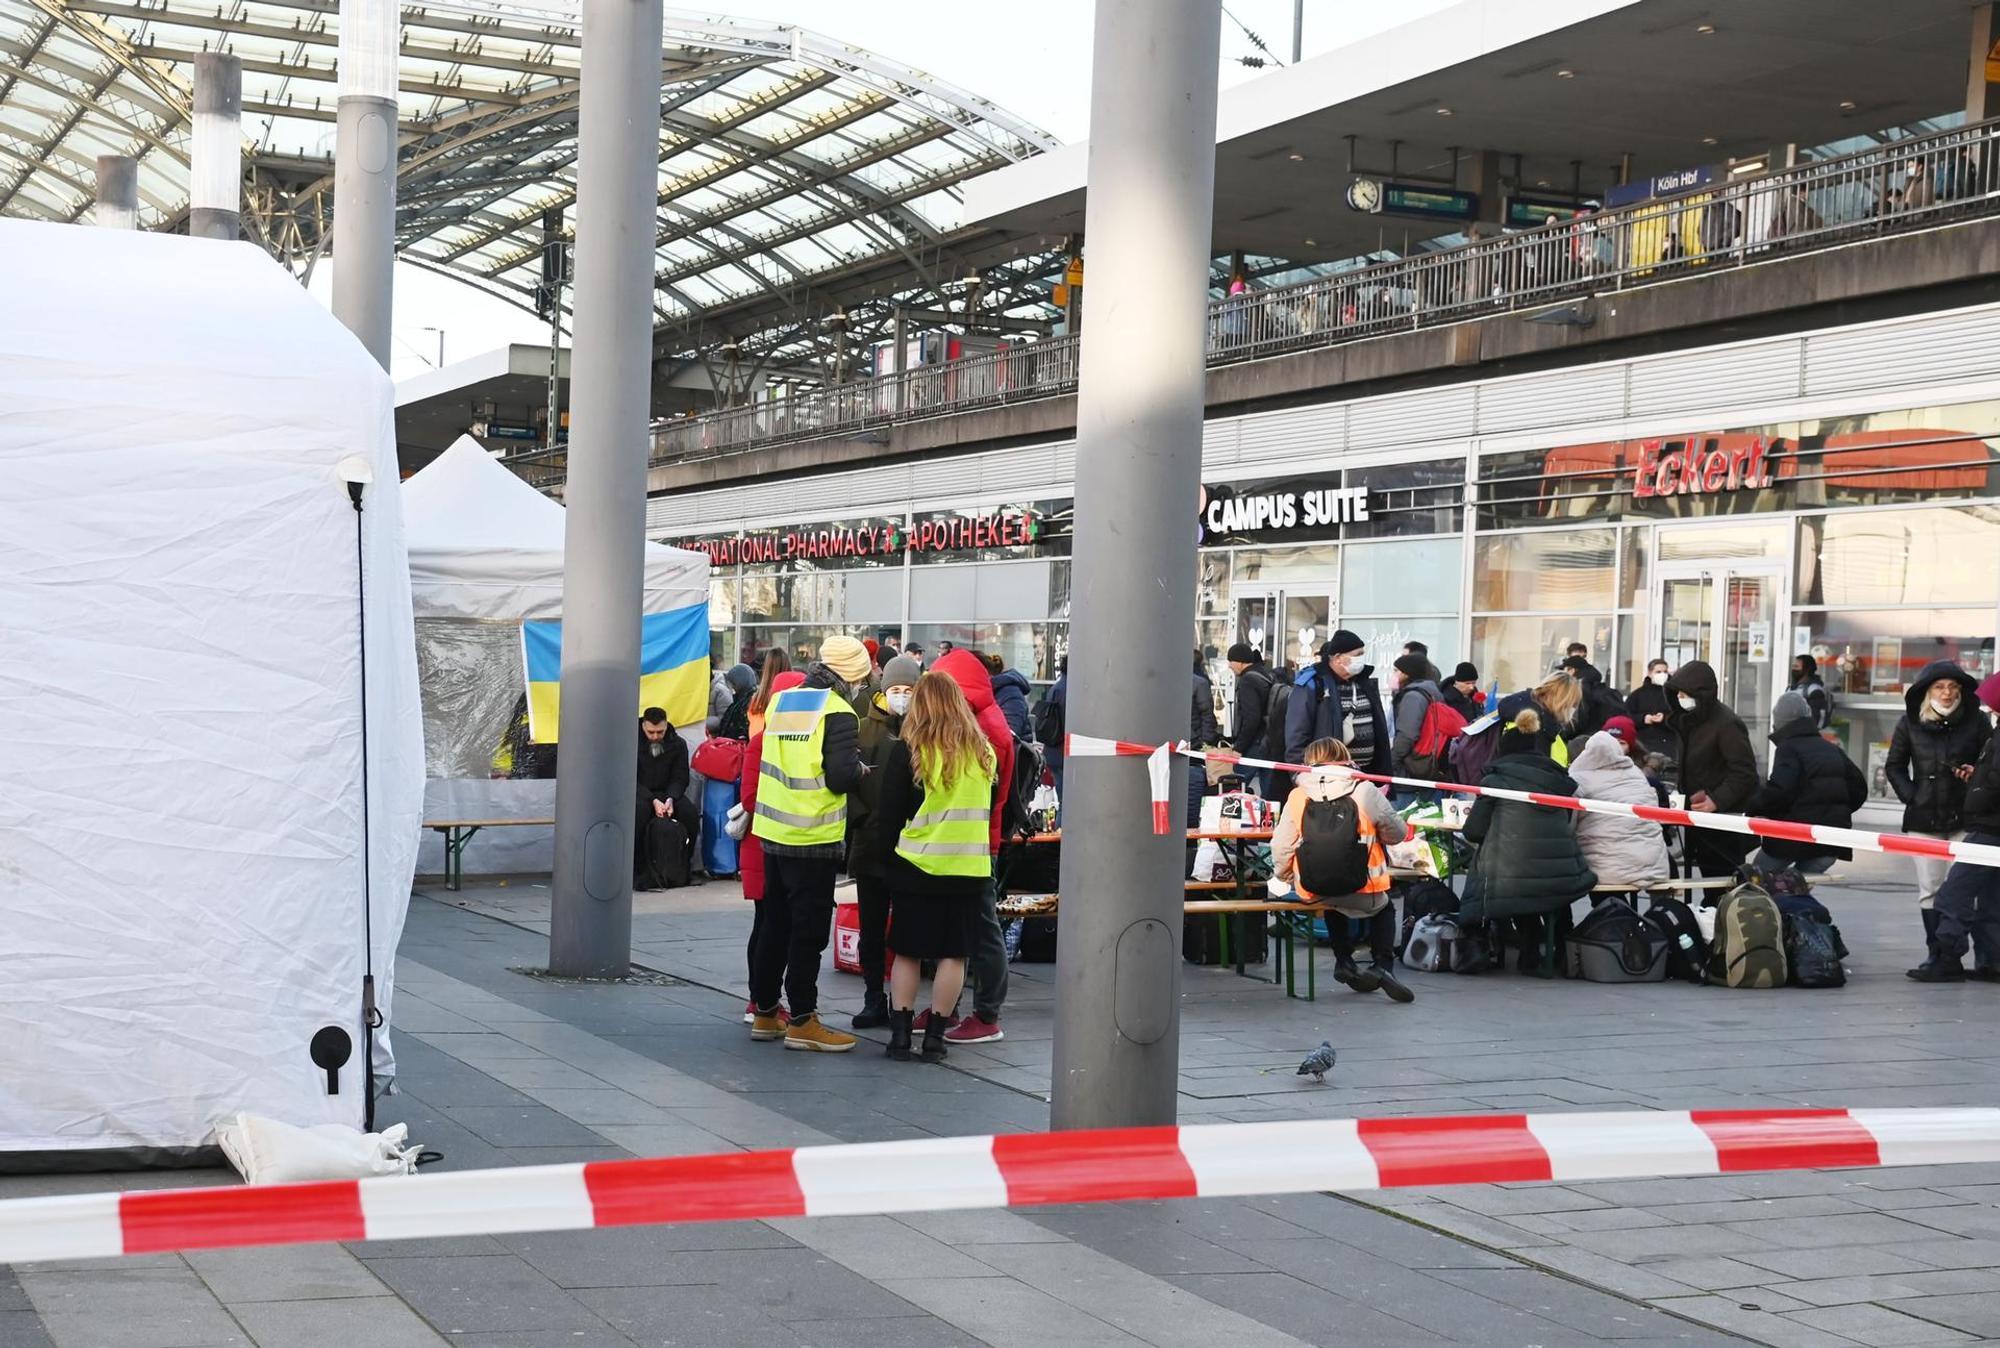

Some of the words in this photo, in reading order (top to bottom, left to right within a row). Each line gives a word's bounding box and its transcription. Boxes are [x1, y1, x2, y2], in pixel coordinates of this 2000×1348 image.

[1657, 176, 1679, 191] Köln
[1680, 169, 1698, 186] Hbf
[1207, 493, 1296, 533] CAMPUS
[1303, 486, 1369, 526] SUITE
[787, 526, 880, 559] PHARMACY
[907, 514, 1014, 552] APOTHEKE
[1753, 634, 1765, 645] 72
[842, 934, 852, 949] K
